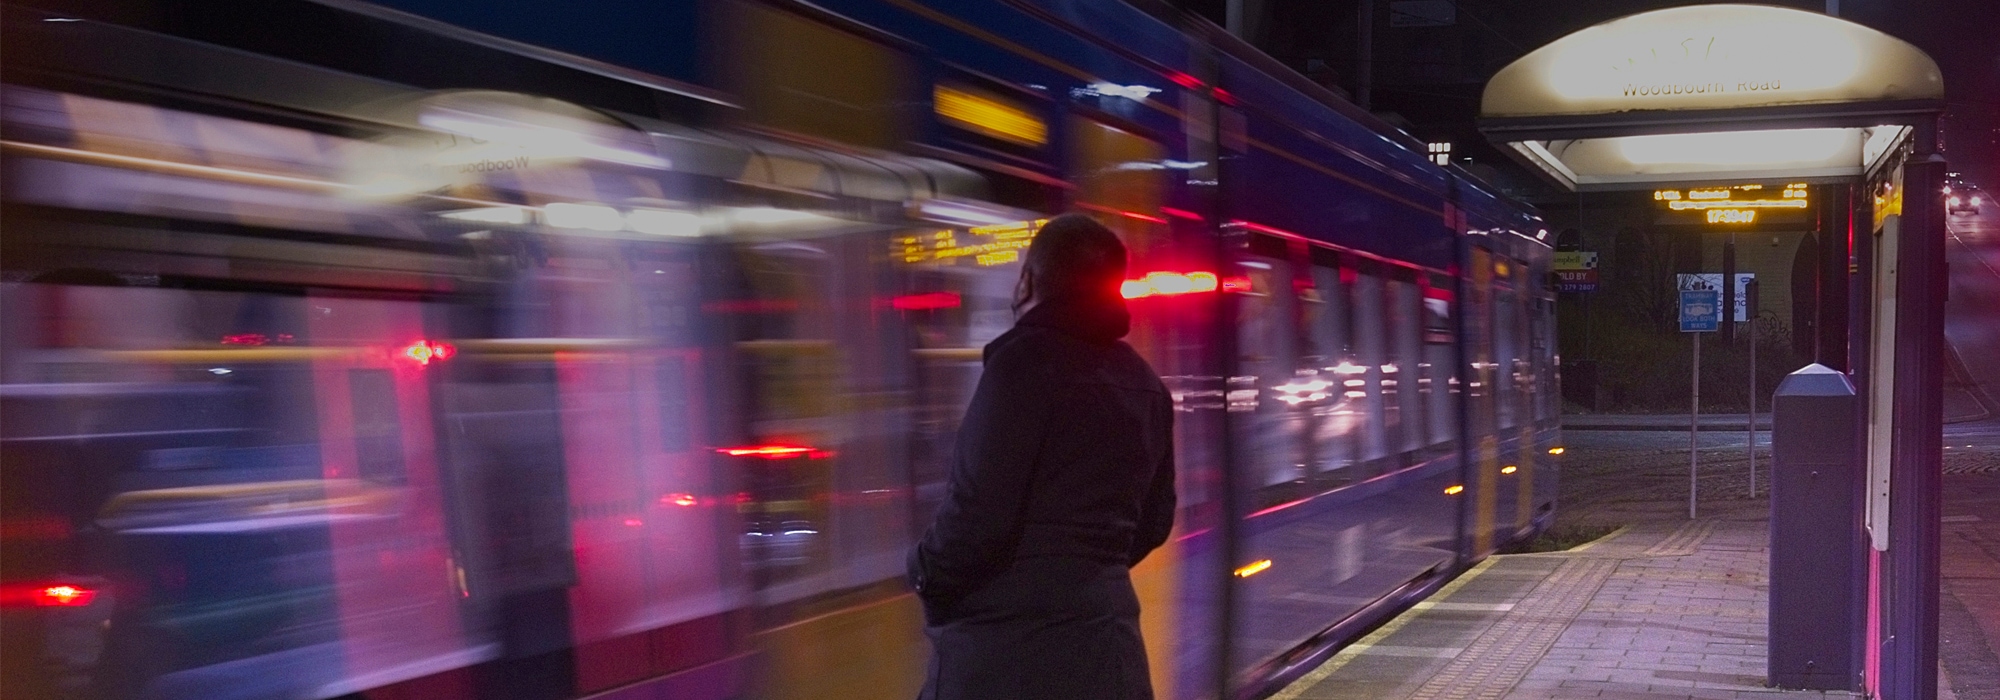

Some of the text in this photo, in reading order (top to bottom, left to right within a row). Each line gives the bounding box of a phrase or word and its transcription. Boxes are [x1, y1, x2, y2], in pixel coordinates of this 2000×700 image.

[1622, 79, 1781, 97] Woodbourn Road
[1576, 272, 1587, 281] BY
